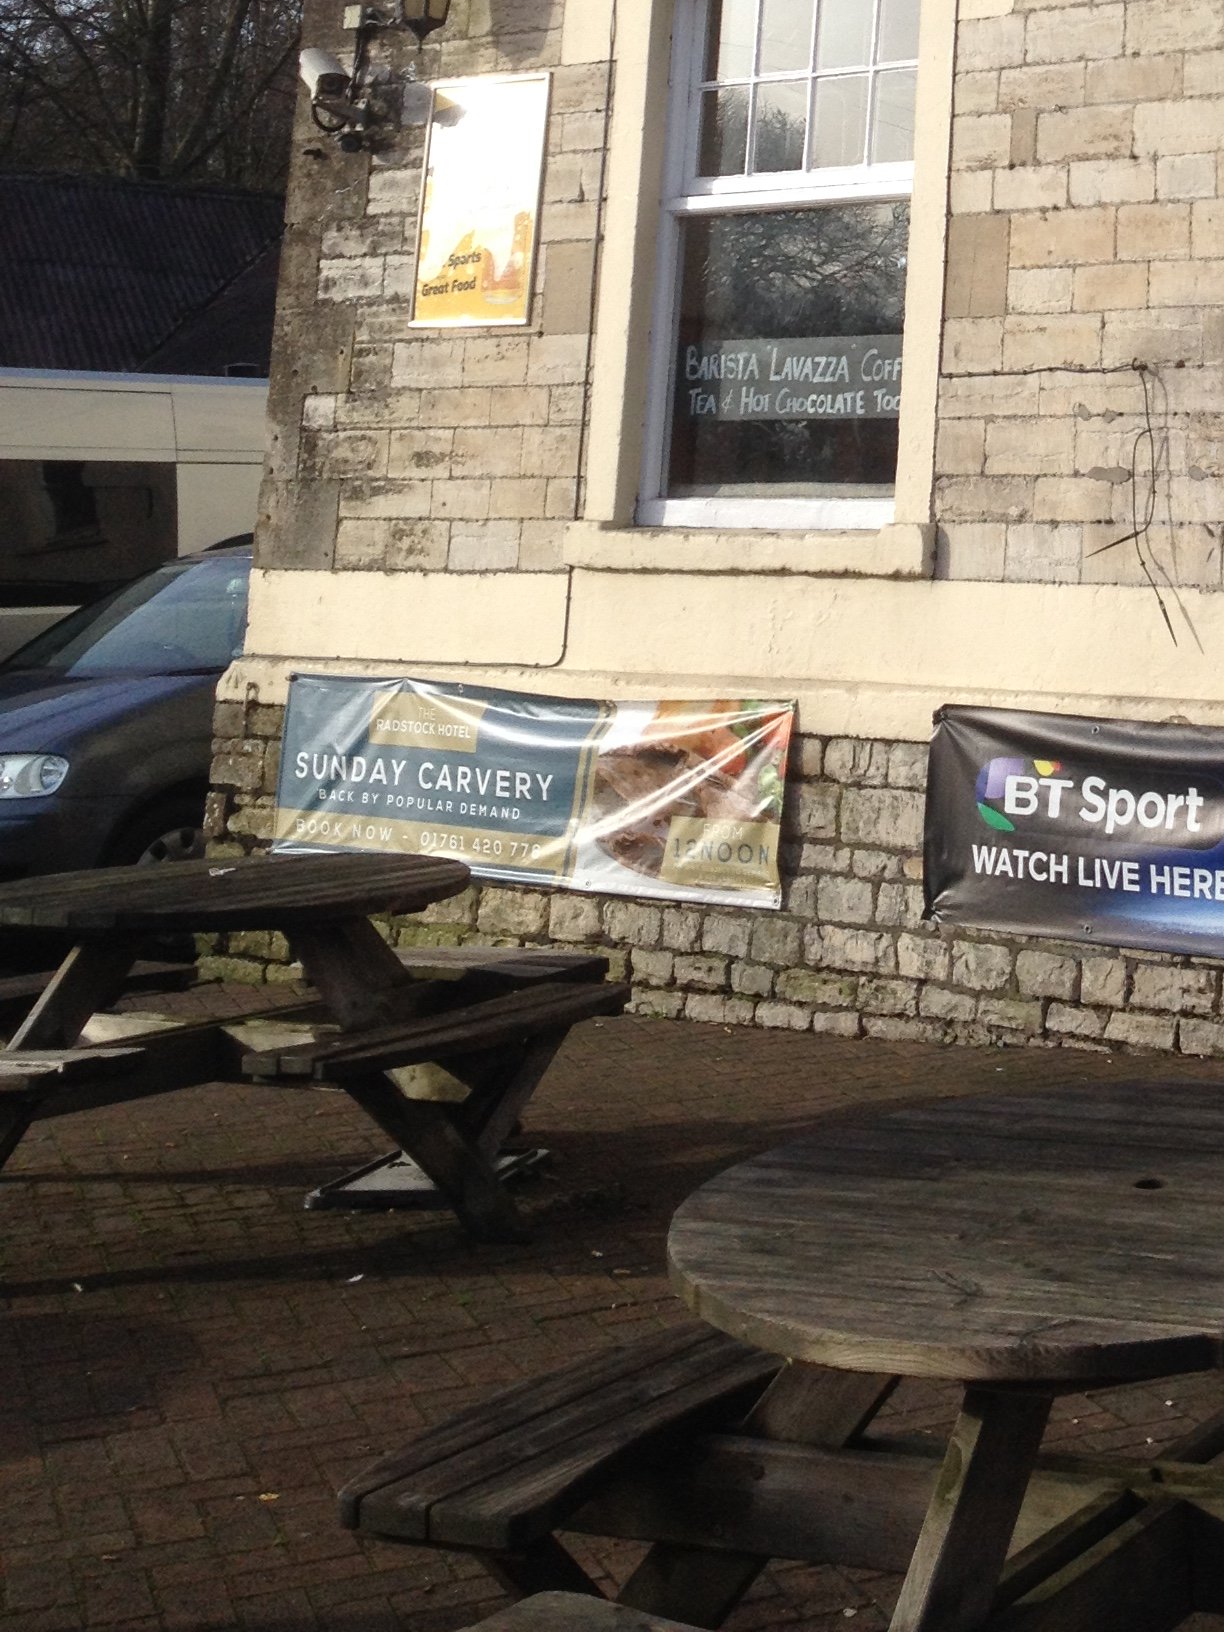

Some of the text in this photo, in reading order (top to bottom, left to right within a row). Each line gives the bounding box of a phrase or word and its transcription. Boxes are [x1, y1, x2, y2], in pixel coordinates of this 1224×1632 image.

[421, 276, 477, 297] Great Food
[685, 345, 759, 380] BARISTA
[769, 347, 849, 383] LAVAZZA
[689, 388, 716, 415] TEA
[740, 387, 771, 415] HOT
[775, 387, 865, 415] CHOCOLATE
[376, 720, 471, 739] RADSTOCK HOTEL
[418, 707, 436, 721] THE
[295, 751, 553, 801] SUNDAY CARVERY
[318, 788, 520, 820] BACK BY POPULAR DEMAND
[1004, 774, 1203, 834] BT Sport
[296, 819, 342, 838] BOOK
[352, 824, 393, 841] NOW
[420, 831, 465, 851] 01761
[472, 838, 502, 855] 420
[704, 824, 743, 839] FROM
[972, 844, 1069, 884] WATCH
[1078, 856, 1140, 892] LIVE
